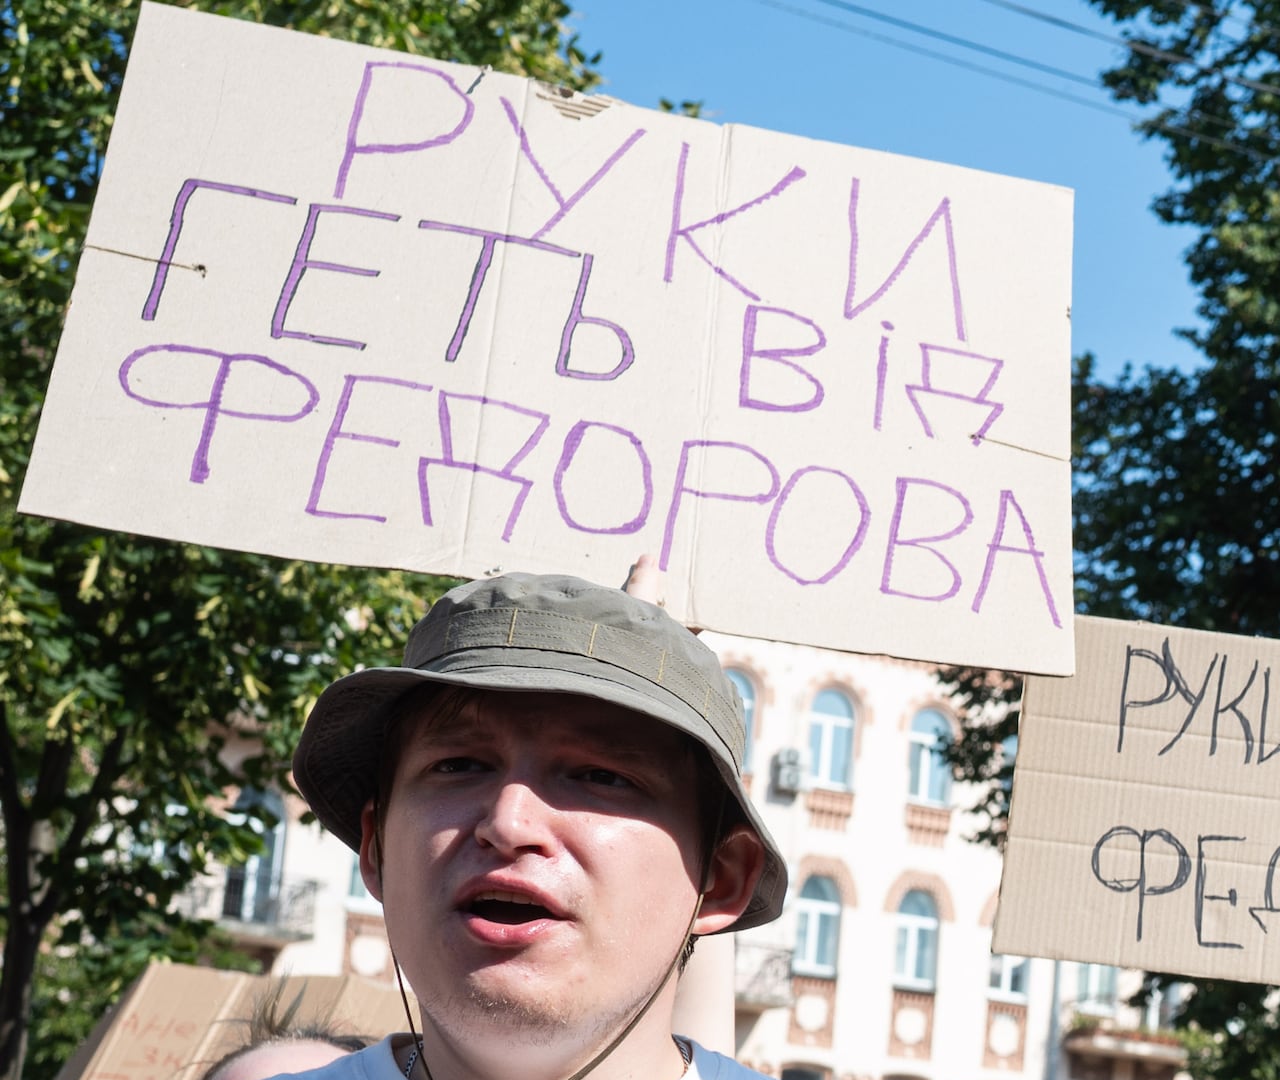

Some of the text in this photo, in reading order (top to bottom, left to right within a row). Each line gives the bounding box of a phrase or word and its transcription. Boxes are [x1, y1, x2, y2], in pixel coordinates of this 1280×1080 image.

[141, 178, 636, 381] ГЕТЬ
[334, 61, 968, 342] РУКИ
[118, 343, 1063, 630] ФЕДОРОВА
